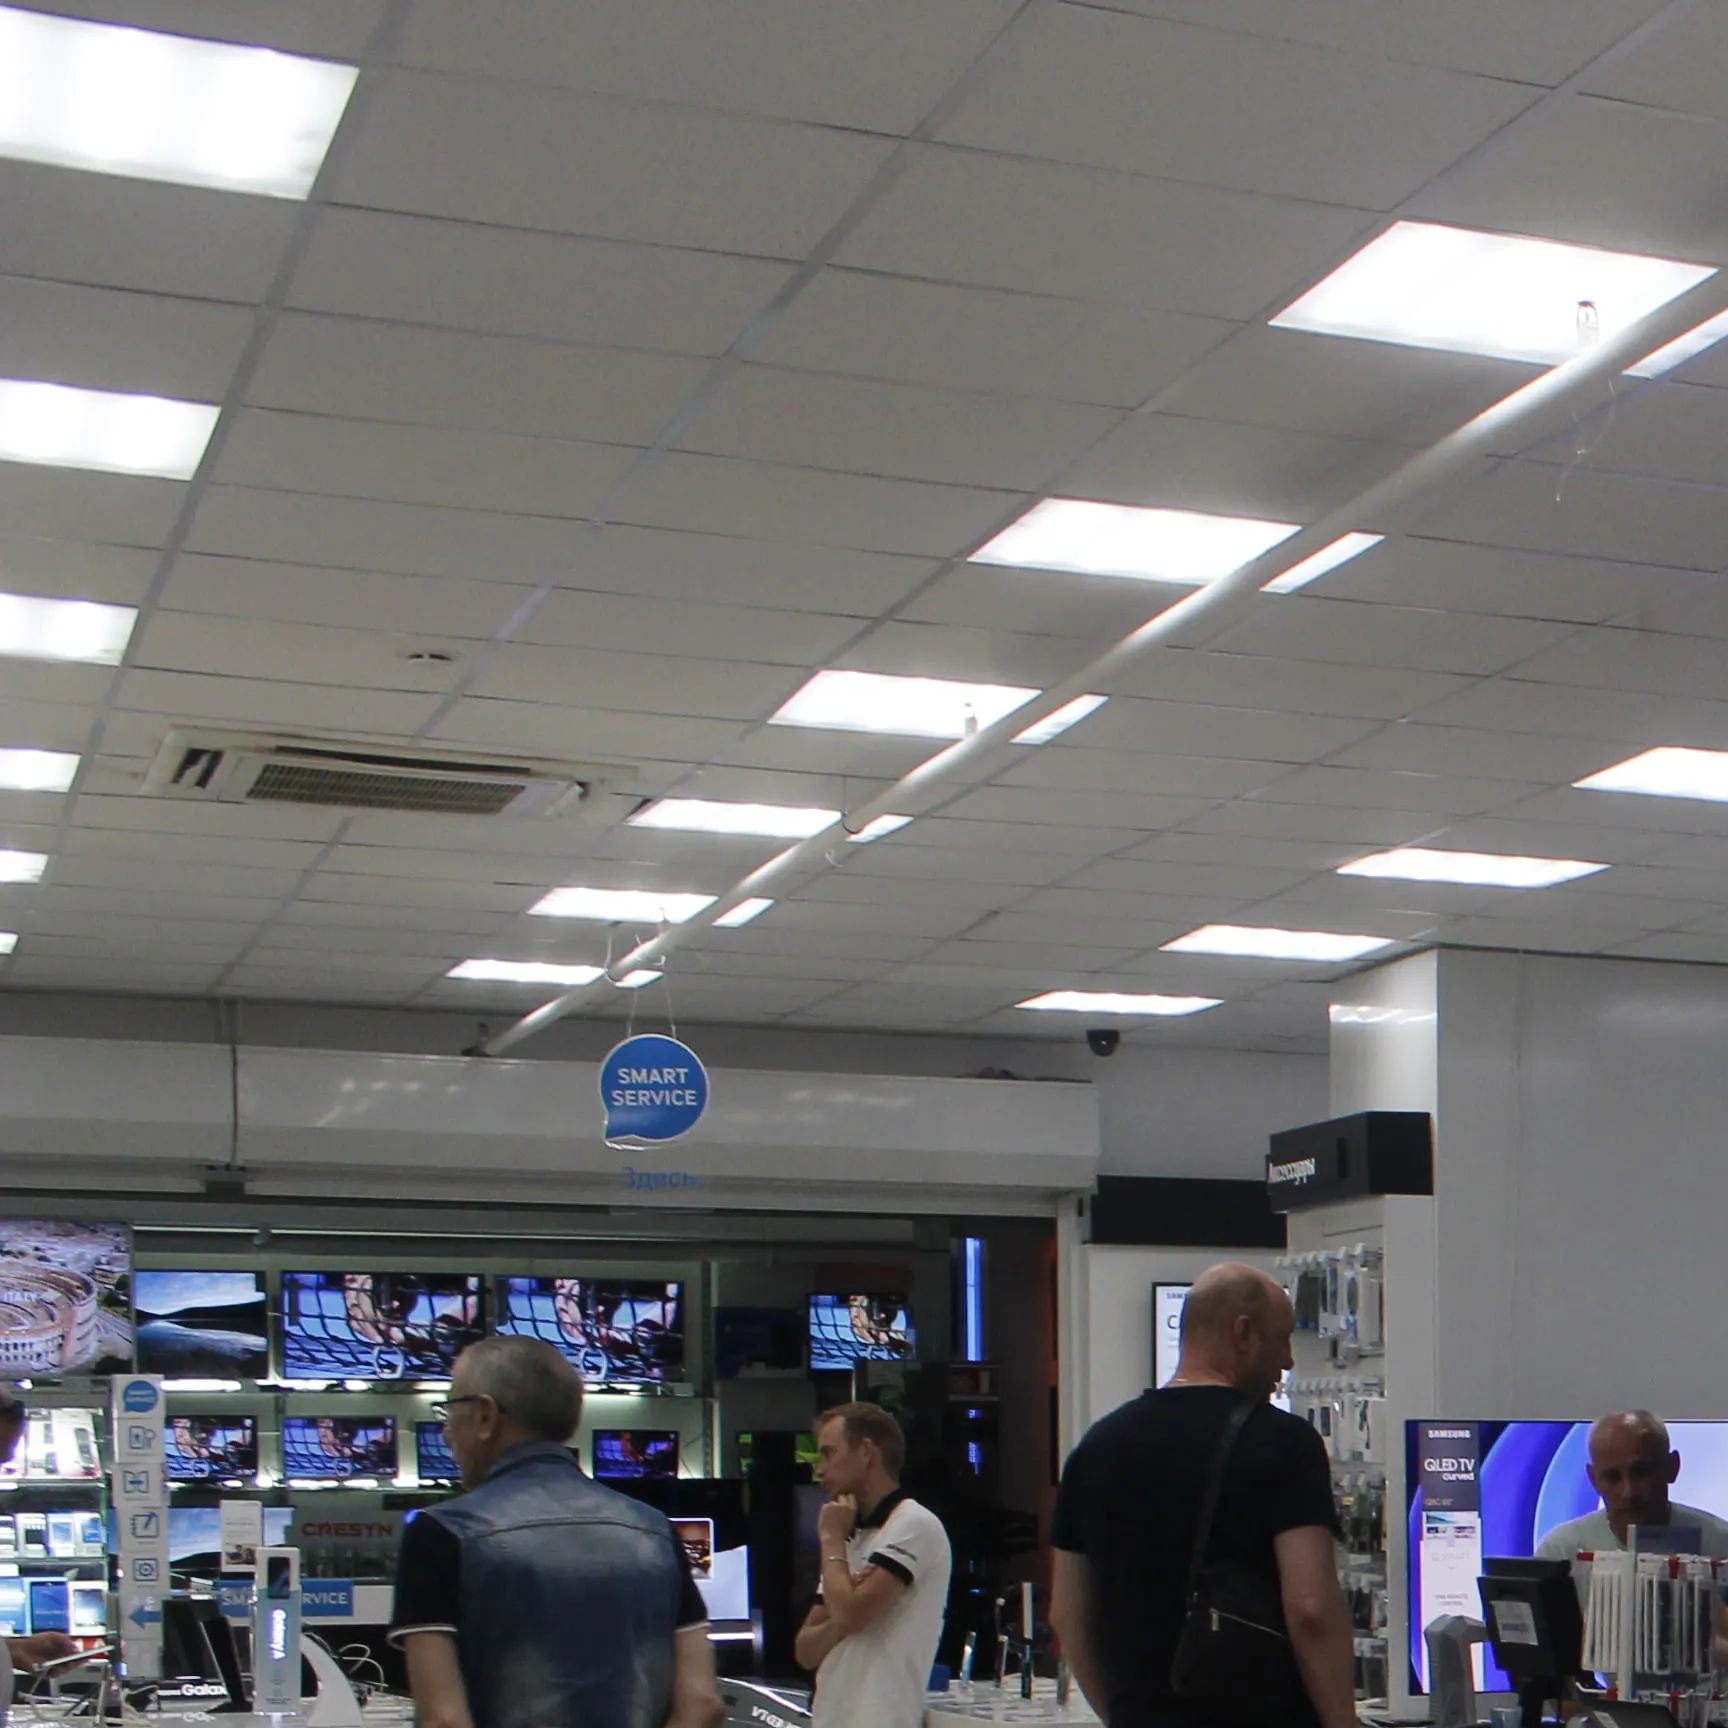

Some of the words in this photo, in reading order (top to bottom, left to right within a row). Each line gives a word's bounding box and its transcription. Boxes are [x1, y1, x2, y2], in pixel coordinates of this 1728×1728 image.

[617, 1067, 689, 1085] SMART
[611, 1089, 698, 1107] SERVICE
[619, 1166, 698, 1193] Здесь
[1423, 1458, 1458, 1472] QLED
[1458, 1458, 1475, 1472] TV
[301, 1521, 393, 1538] CRESYN
[271, 1608, 287, 1649] Galaxy
[272, 1649, 286, 1661] A
[180, 1682, 227, 1697] Galax
